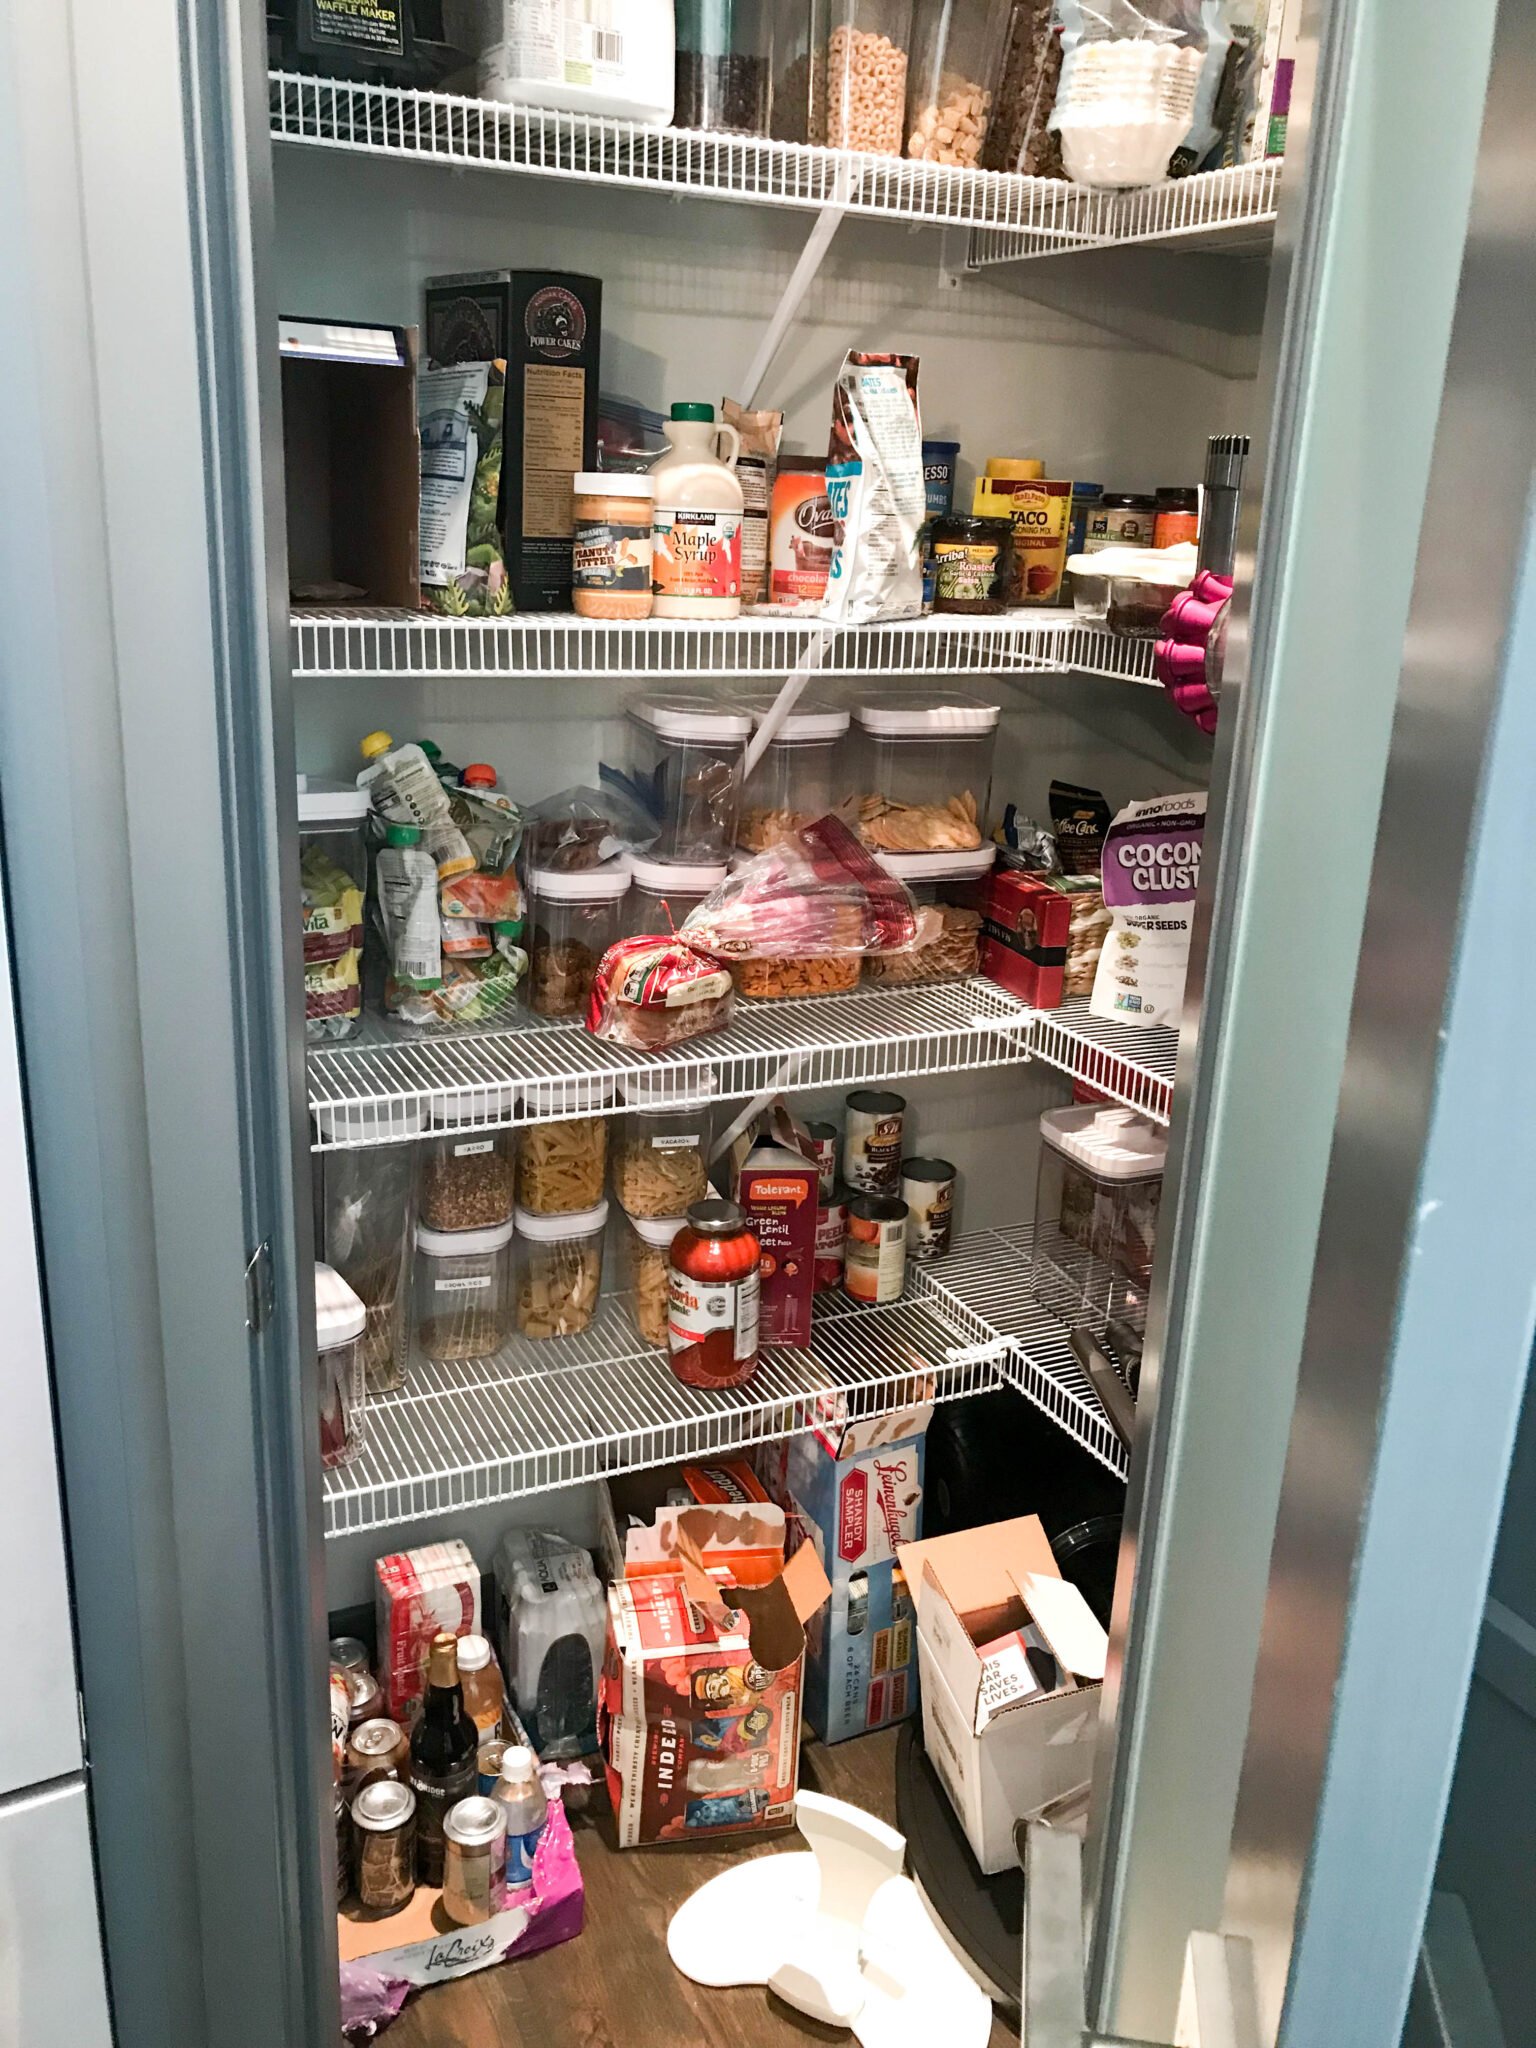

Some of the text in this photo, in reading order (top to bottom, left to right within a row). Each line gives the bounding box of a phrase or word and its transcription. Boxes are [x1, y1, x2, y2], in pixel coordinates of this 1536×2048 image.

[317, 1, 396, 21] WAFFLE MAKER
[529, 335, 582, 351] POWER CAKES
[527, 367, 582, 379] Nutrition Facts
[677, 512, 715, 521] KIRKLAND
[1009, 511, 1048, 526] TACO
[672, 531, 717, 549] Maple
[575, 546, 609, 559] PEANUT
[674, 546, 717, 565] Syrup
[960, 561, 996, 572] Roasted
[1135, 799, 1196, 818] innofoods
[1126, 819, 1197, 830] ORGANIC NON-GMO
[1155, 919, 1188, 931] SEEDS
[754, 1183, 802, 1195] Tolerant
[745, 1216, 779, 1227] Green
[759, 1224, 790, 1236] Lentil
[759, 1237, 777, 1247] eet
[873, 1459, 911, 1553] Leinenkugel
[843, 1487, 855, 1550] SAMPLER
[854, 1488, 864, 1542] SHANDY
[847, 1655, 854, 1668] OF
[845, 1670, 853, 1698] EACH
[852, 1678, 860, 1705] CANS
[980, 1673, 1018, 1696] SAVES
[984, 1685, 1018, 1706] LIVES
[657, 1718, 677, 1790] INDEED
[631, 1751, 639, 1783] THIRSTY
